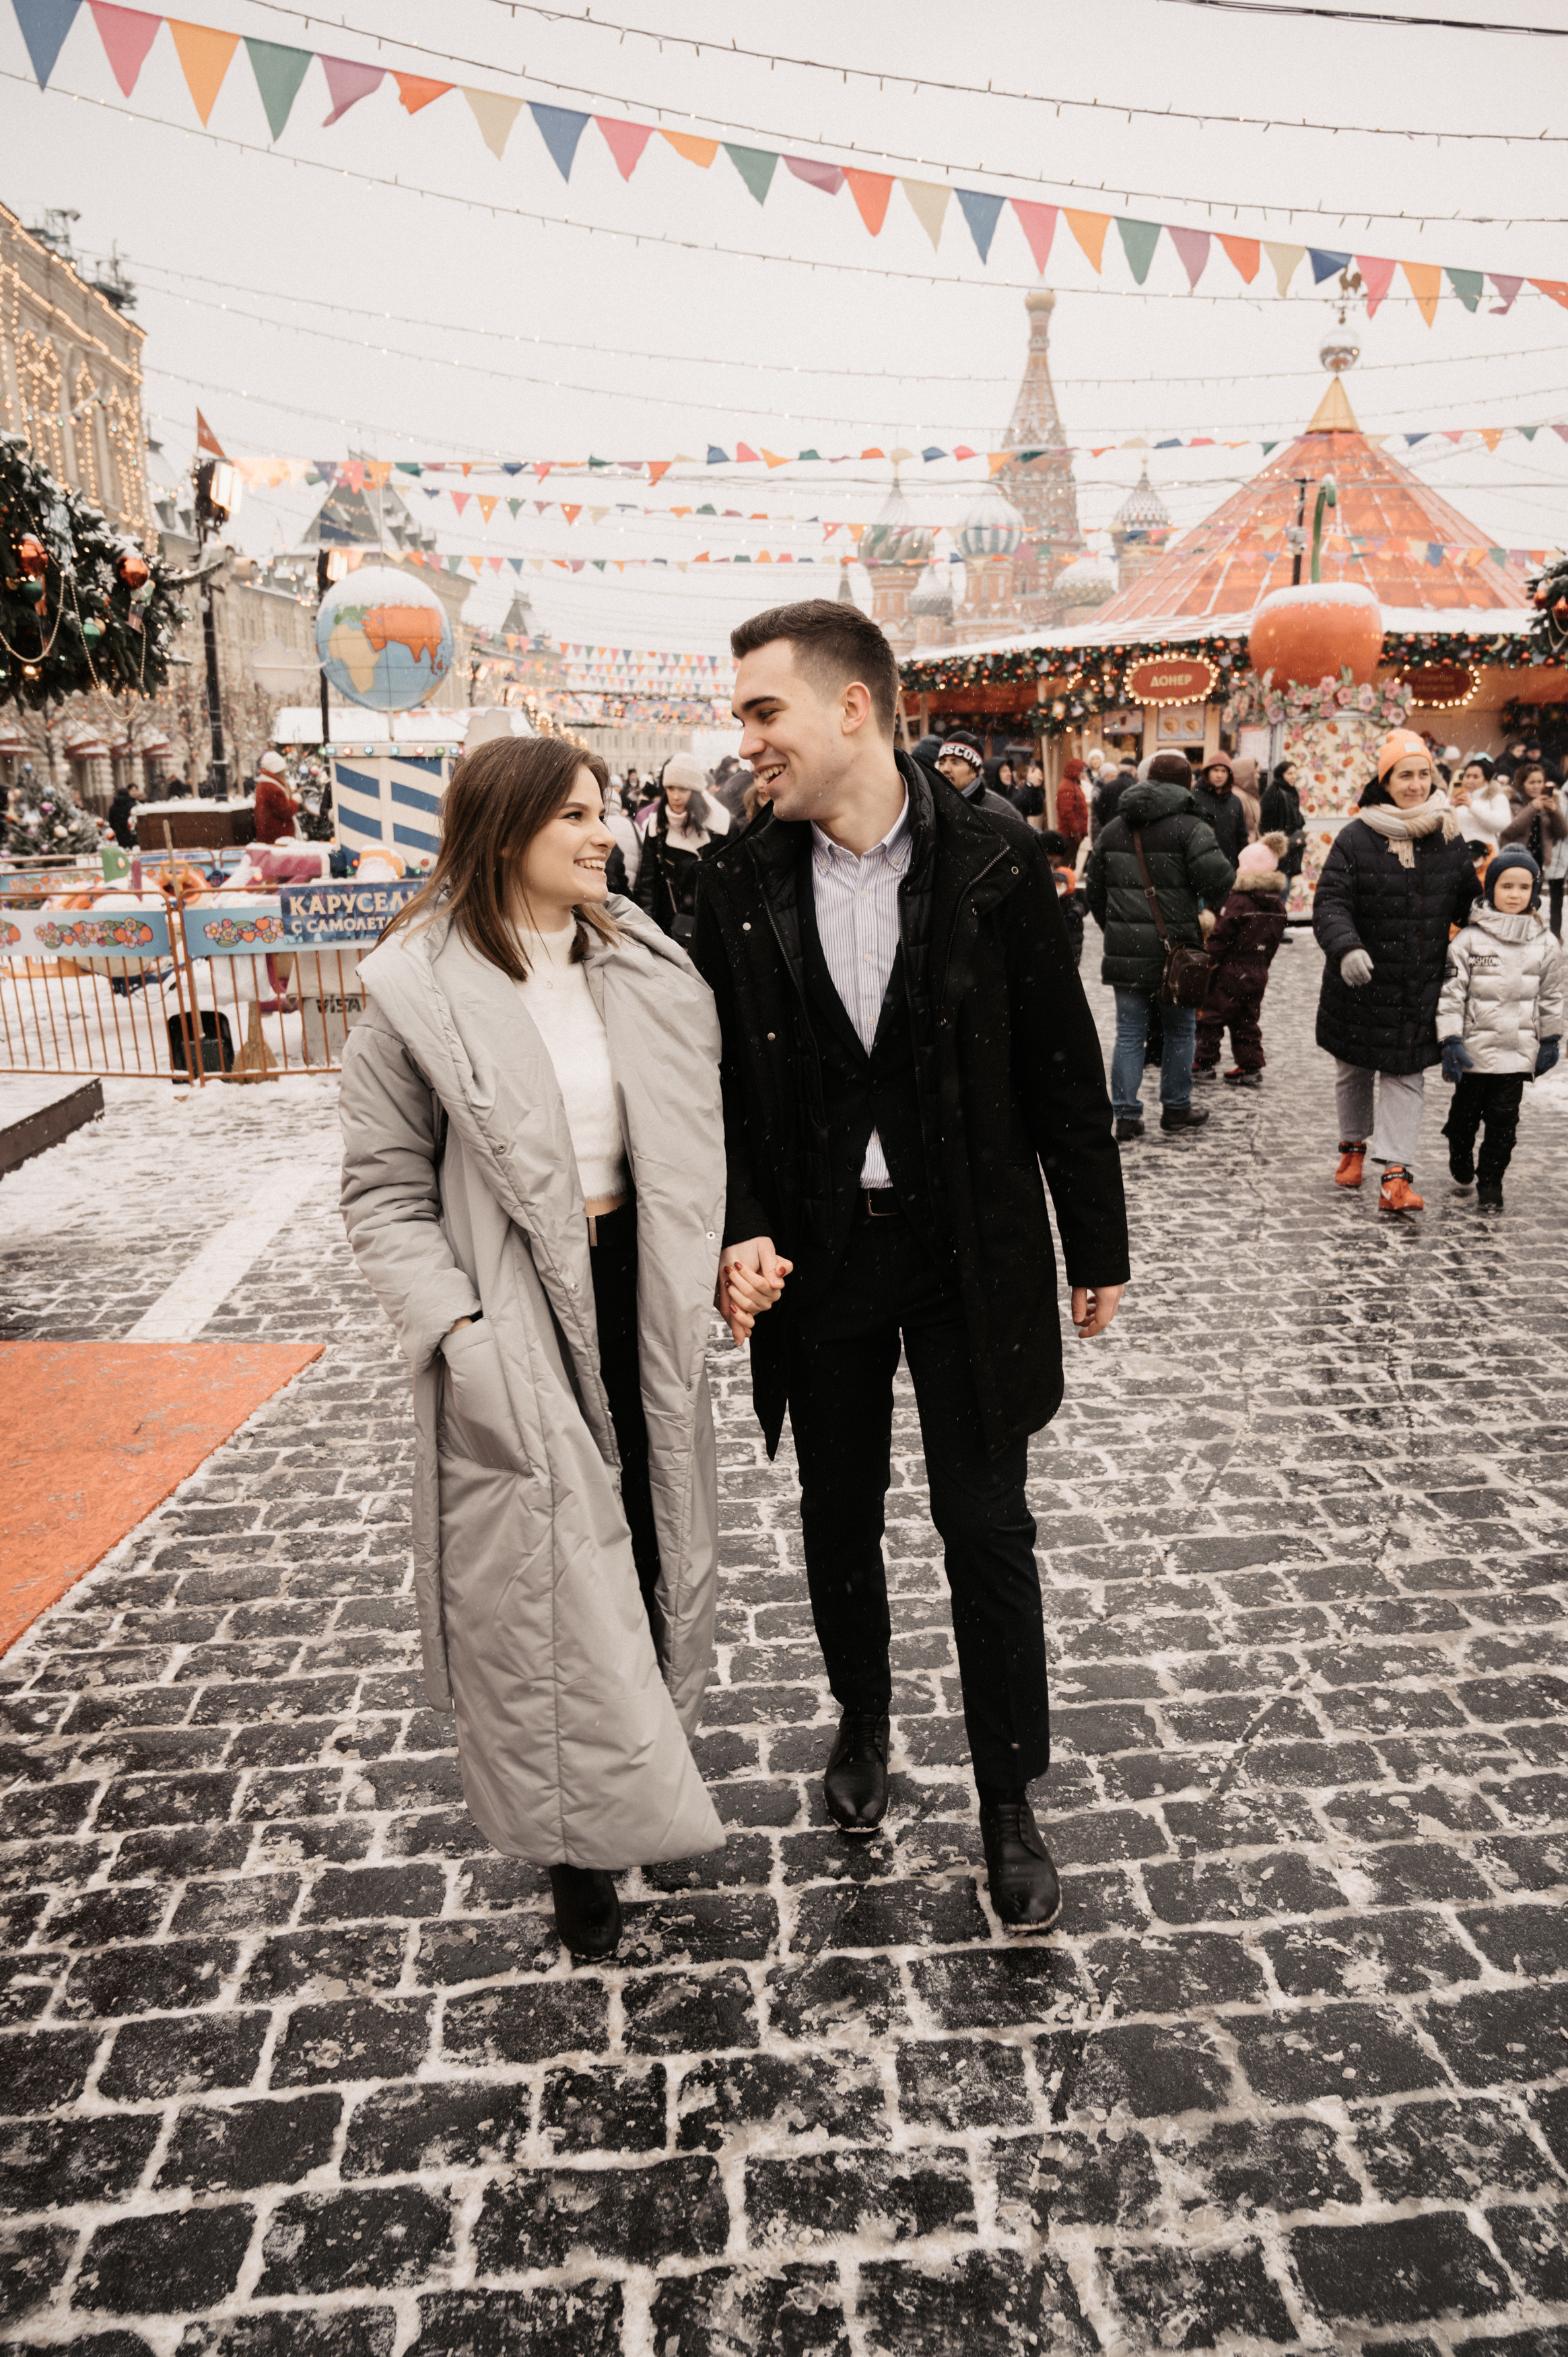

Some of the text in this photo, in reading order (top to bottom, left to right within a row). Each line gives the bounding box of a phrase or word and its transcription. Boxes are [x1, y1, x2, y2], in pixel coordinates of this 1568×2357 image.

[1150, 674, 1192, 687] ДОНЕР
[939, 745, 982, 767] OSCOW
[291, 921, 302, 933] С
[316, 998, 362, 1013] VISA
